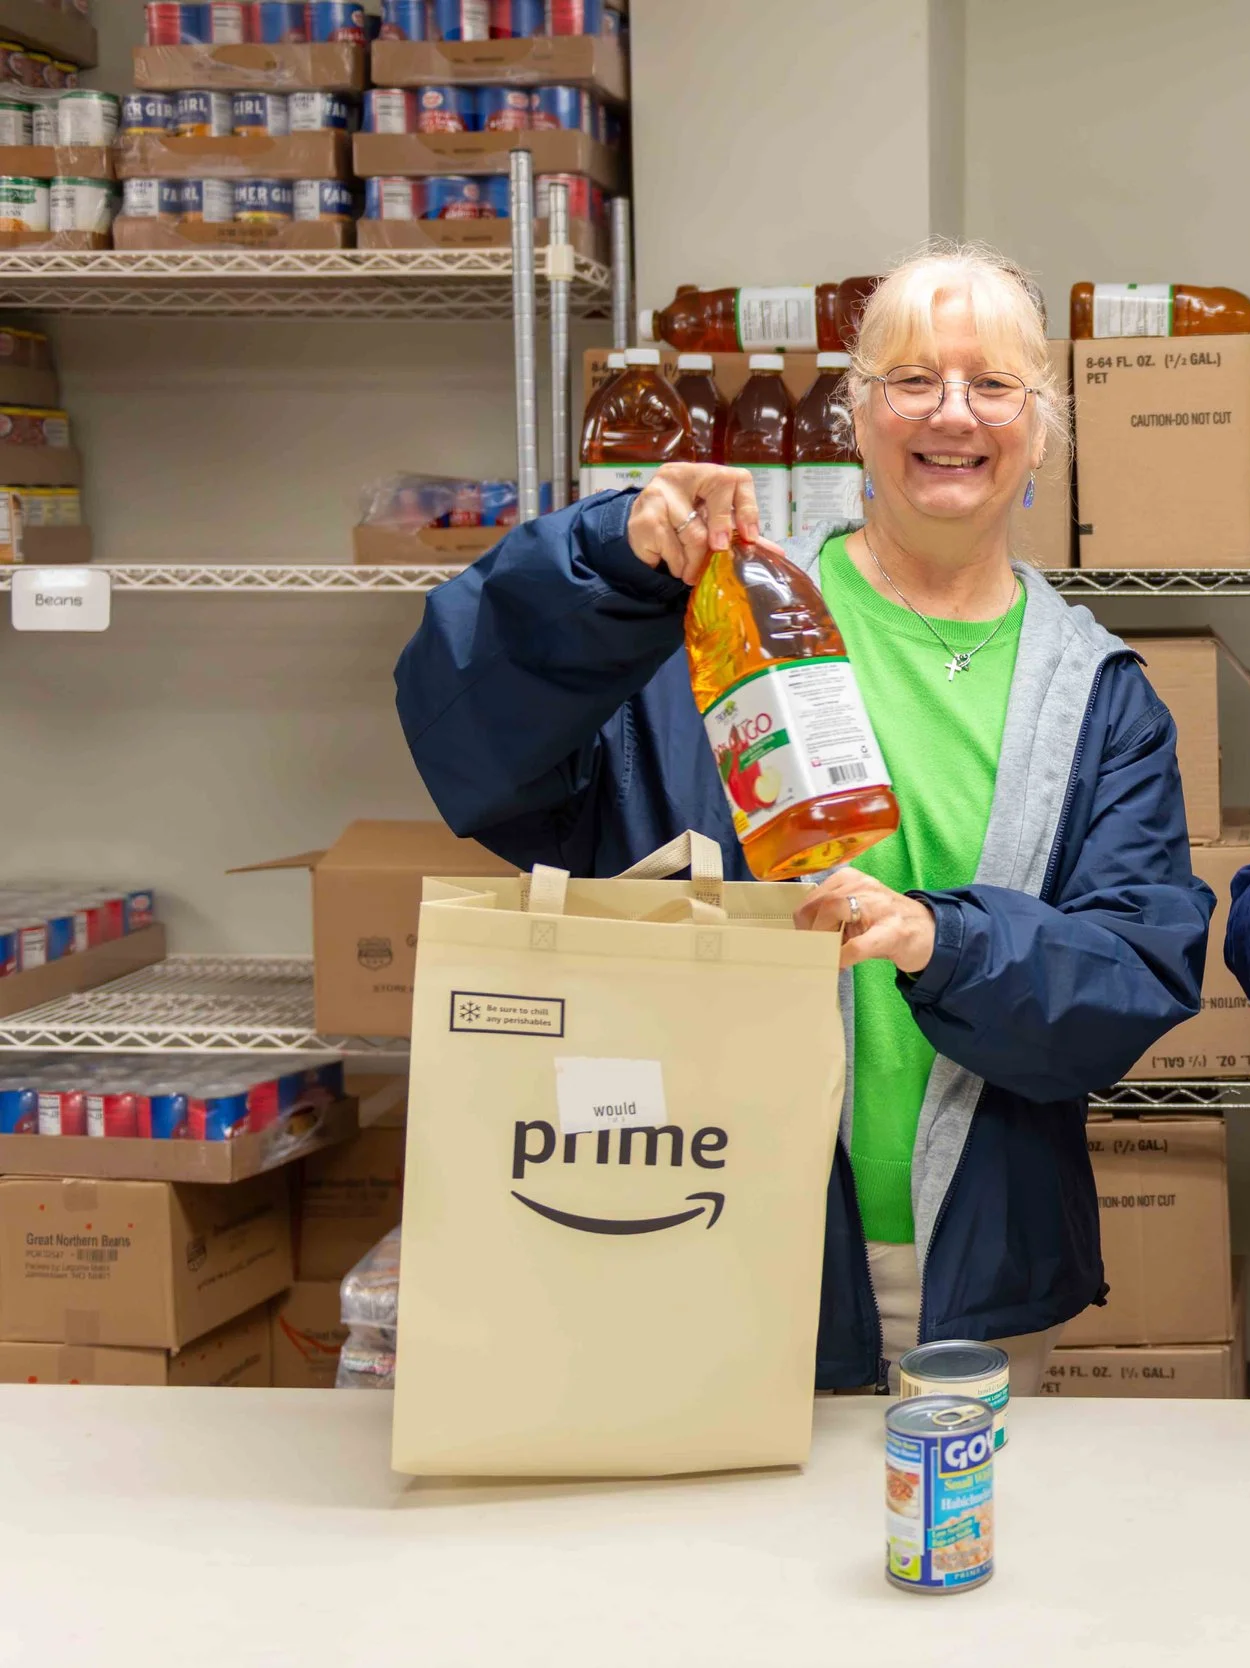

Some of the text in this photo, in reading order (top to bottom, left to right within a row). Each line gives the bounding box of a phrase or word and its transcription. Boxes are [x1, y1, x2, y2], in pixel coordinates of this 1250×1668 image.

[1086, 357, 1112, 369] 8-64
[1116, 357, 1133, 368] FL.
[1137, 355, 1156, 367] OZ.
[1190, 352, 1222, 367] GAL.)
[1086, 372, 1108, 384] PET
[1131, 411, 1232, 428] CAUTION-DO NOT CUT
[34, 593, 84, 607] Beans
[486, 1004, 549, 1016] Be sure to chill
[486, 1016, 552, 1027] any perishables
[1151, 1055, 1185, 1069] GAL.)
[1215, 1055, 1236, 1067] OZ.
[593, 1101, 637, 1117] would
[511, 1120, 728, 1180] prime
[1138, 1139, 1168, 1153] GAL.)
[1136, 1195, 1156, 1207] NOT
[1157, 1194, 1176, 1207] CUT
[26, 1232, 132, 1248] Great Northern Beans
[1069, 1366, 1089, 1378] FL.
[1092, 1366, 1112, 1379] OZ.
[1142, 1367, 1176, 1380] GAL.)
